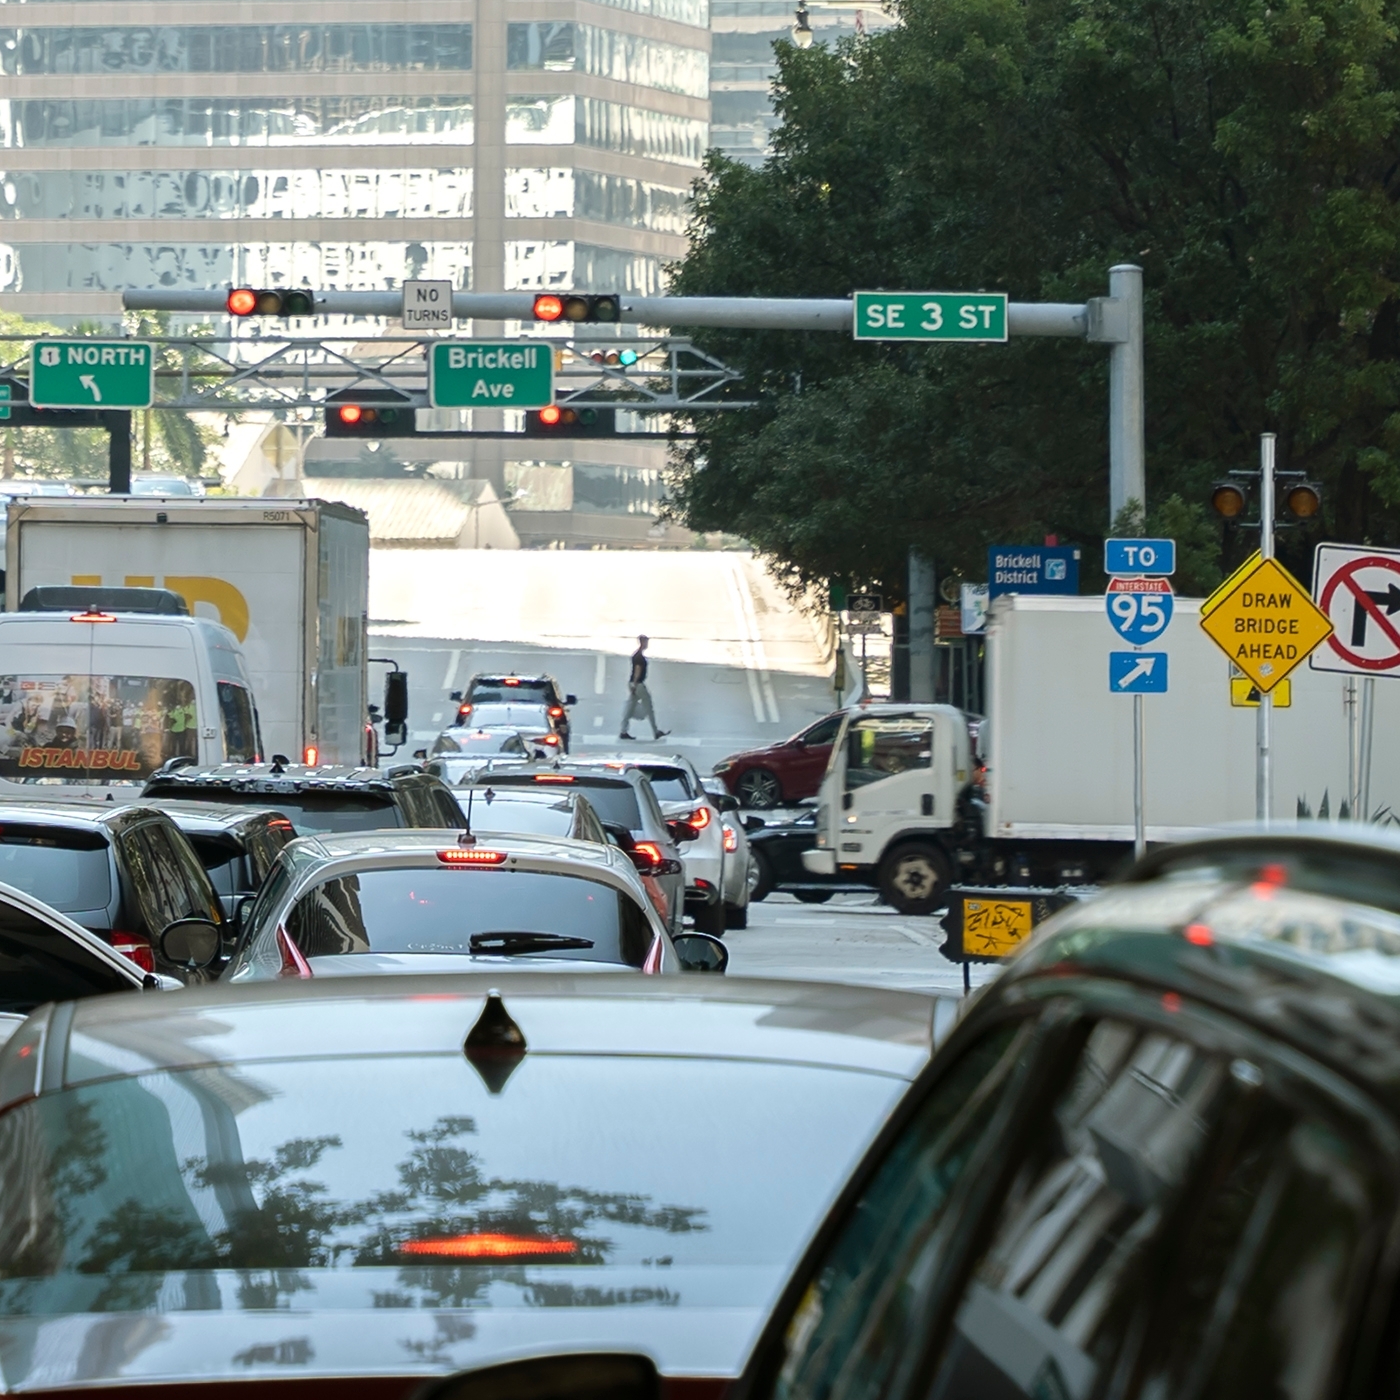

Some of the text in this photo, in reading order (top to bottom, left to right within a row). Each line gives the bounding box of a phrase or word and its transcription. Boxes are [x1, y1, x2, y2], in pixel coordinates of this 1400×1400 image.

[416, 288, 439, 303] NO
[407, 309, 449, 322] TURNS
[866, 302, 997, 332] SE 3 ST
[67, 347, 145, 366] NORTH
[448, 348, 537, 369] Brickell
[472, 379, 515, 398] Ave
[262, 511, 290, 522] R5071
[995, 554, 1041, 569] Brickell
[1123, 547, 1156, 568] TO
[995, 571, 1038, 585] District
[1116, 581, 1164, 593] INTERSTATE
[1242, 593, 1292, 609] DRAW
[1111, 595, 1166, 634] 95
[1234, 618, 1300, 635] BRIDGE
[1236, 643, 1298, 660] AHEAD
[18, 747, 141, 770] ISTANBUL
